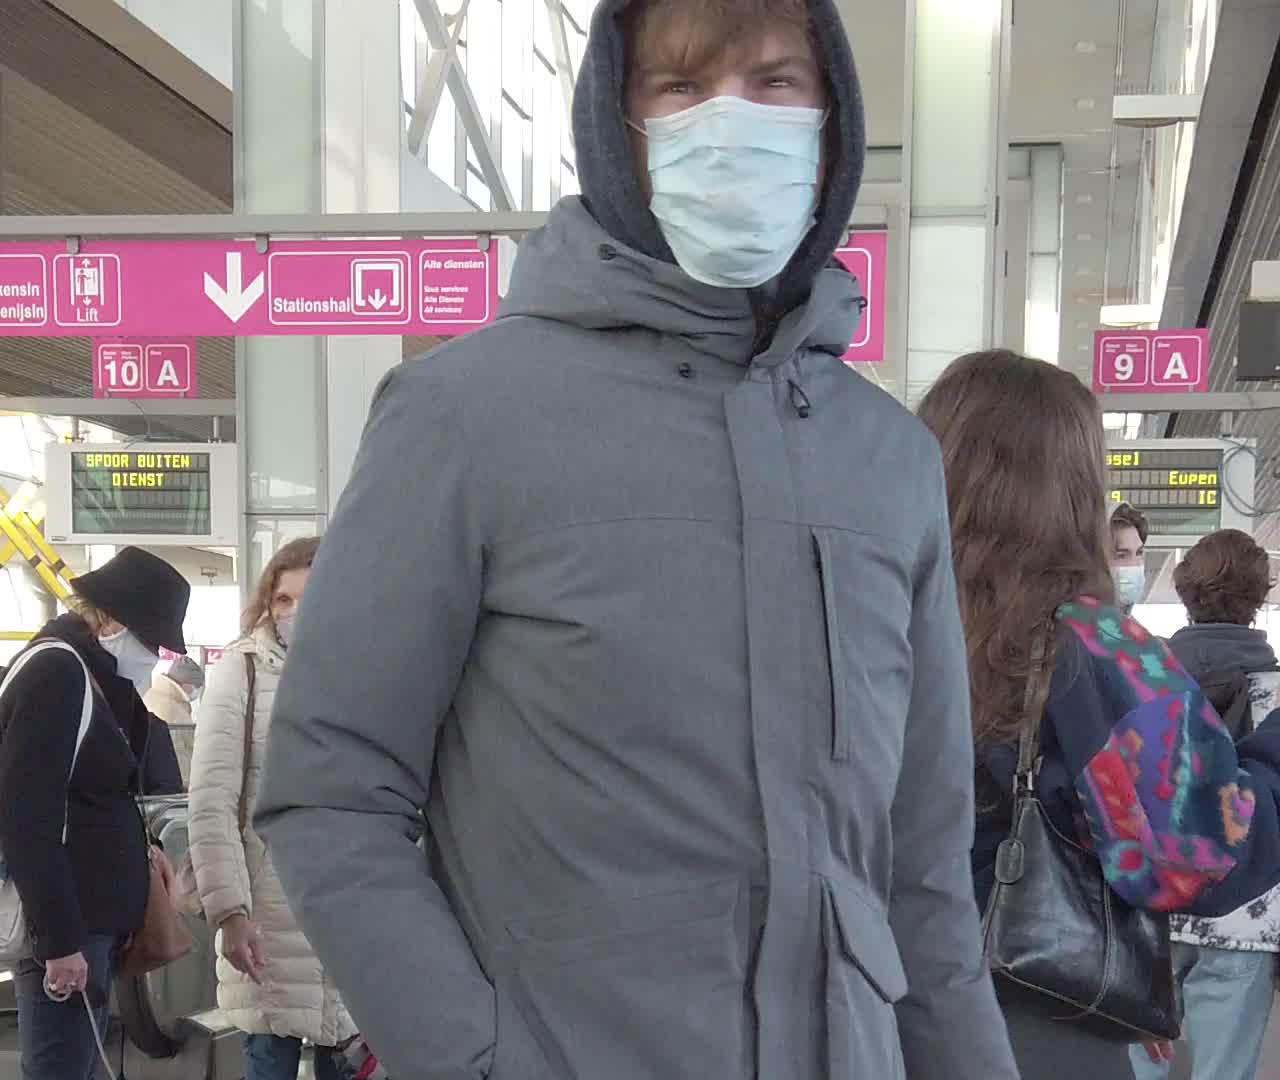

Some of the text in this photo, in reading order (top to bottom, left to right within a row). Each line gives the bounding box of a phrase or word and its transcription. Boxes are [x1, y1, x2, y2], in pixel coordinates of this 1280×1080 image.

[76, 308, 99, 322] Lift
[104, 360, 180, 386] 10 A
[1114, 352, 1189, 380] 9 A
[86, 454, 190, 468] SPOOR BUITEN
[1105, 451, 1139, 466] ssel
[112, 472, 164, 487] DIENST
[1169, 471, 1217, 485] Eupen
[1199, 490, 1217, 505] IC
